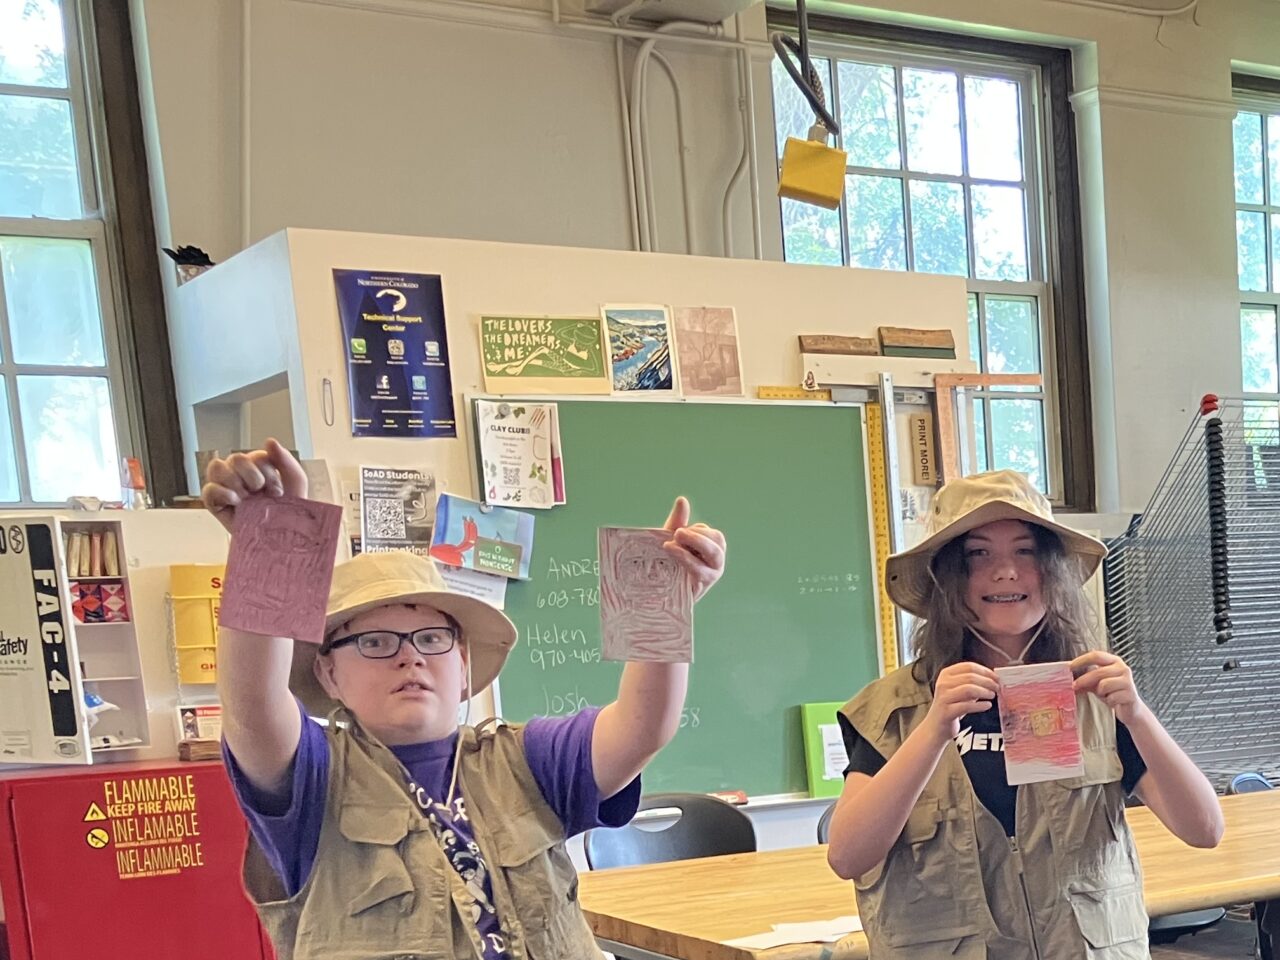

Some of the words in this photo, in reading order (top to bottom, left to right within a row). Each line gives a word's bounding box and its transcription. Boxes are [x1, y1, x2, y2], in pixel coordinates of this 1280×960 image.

[484, 320, 506, 332] THE
[484, 334, 502, 343] THE
[504, 347, 524, 361] ME
[490, 424, 507, 433] CLAY
[917, 418, 928, 447] PRINT
[363, 469, 385, 479] SoAD
[920, 449, 930, 481] MORE!
[33, 569, 70, 694] FAC-4
[527, 623, 586, 647] Helen
[0, 636, 28, 656] afety
[537, 684, 590, 719] Josh
[104, 775, 196, 804] FLAMMABLE
[107, 803, 136, 817] KEEP
[137, 801, 162, 815] FIRE
[164, 798, 196, 813] AWAY
[112, 813, 200, 842] INFLAMABLE
[116, 843, 204, 873] INFLAMMABLE
